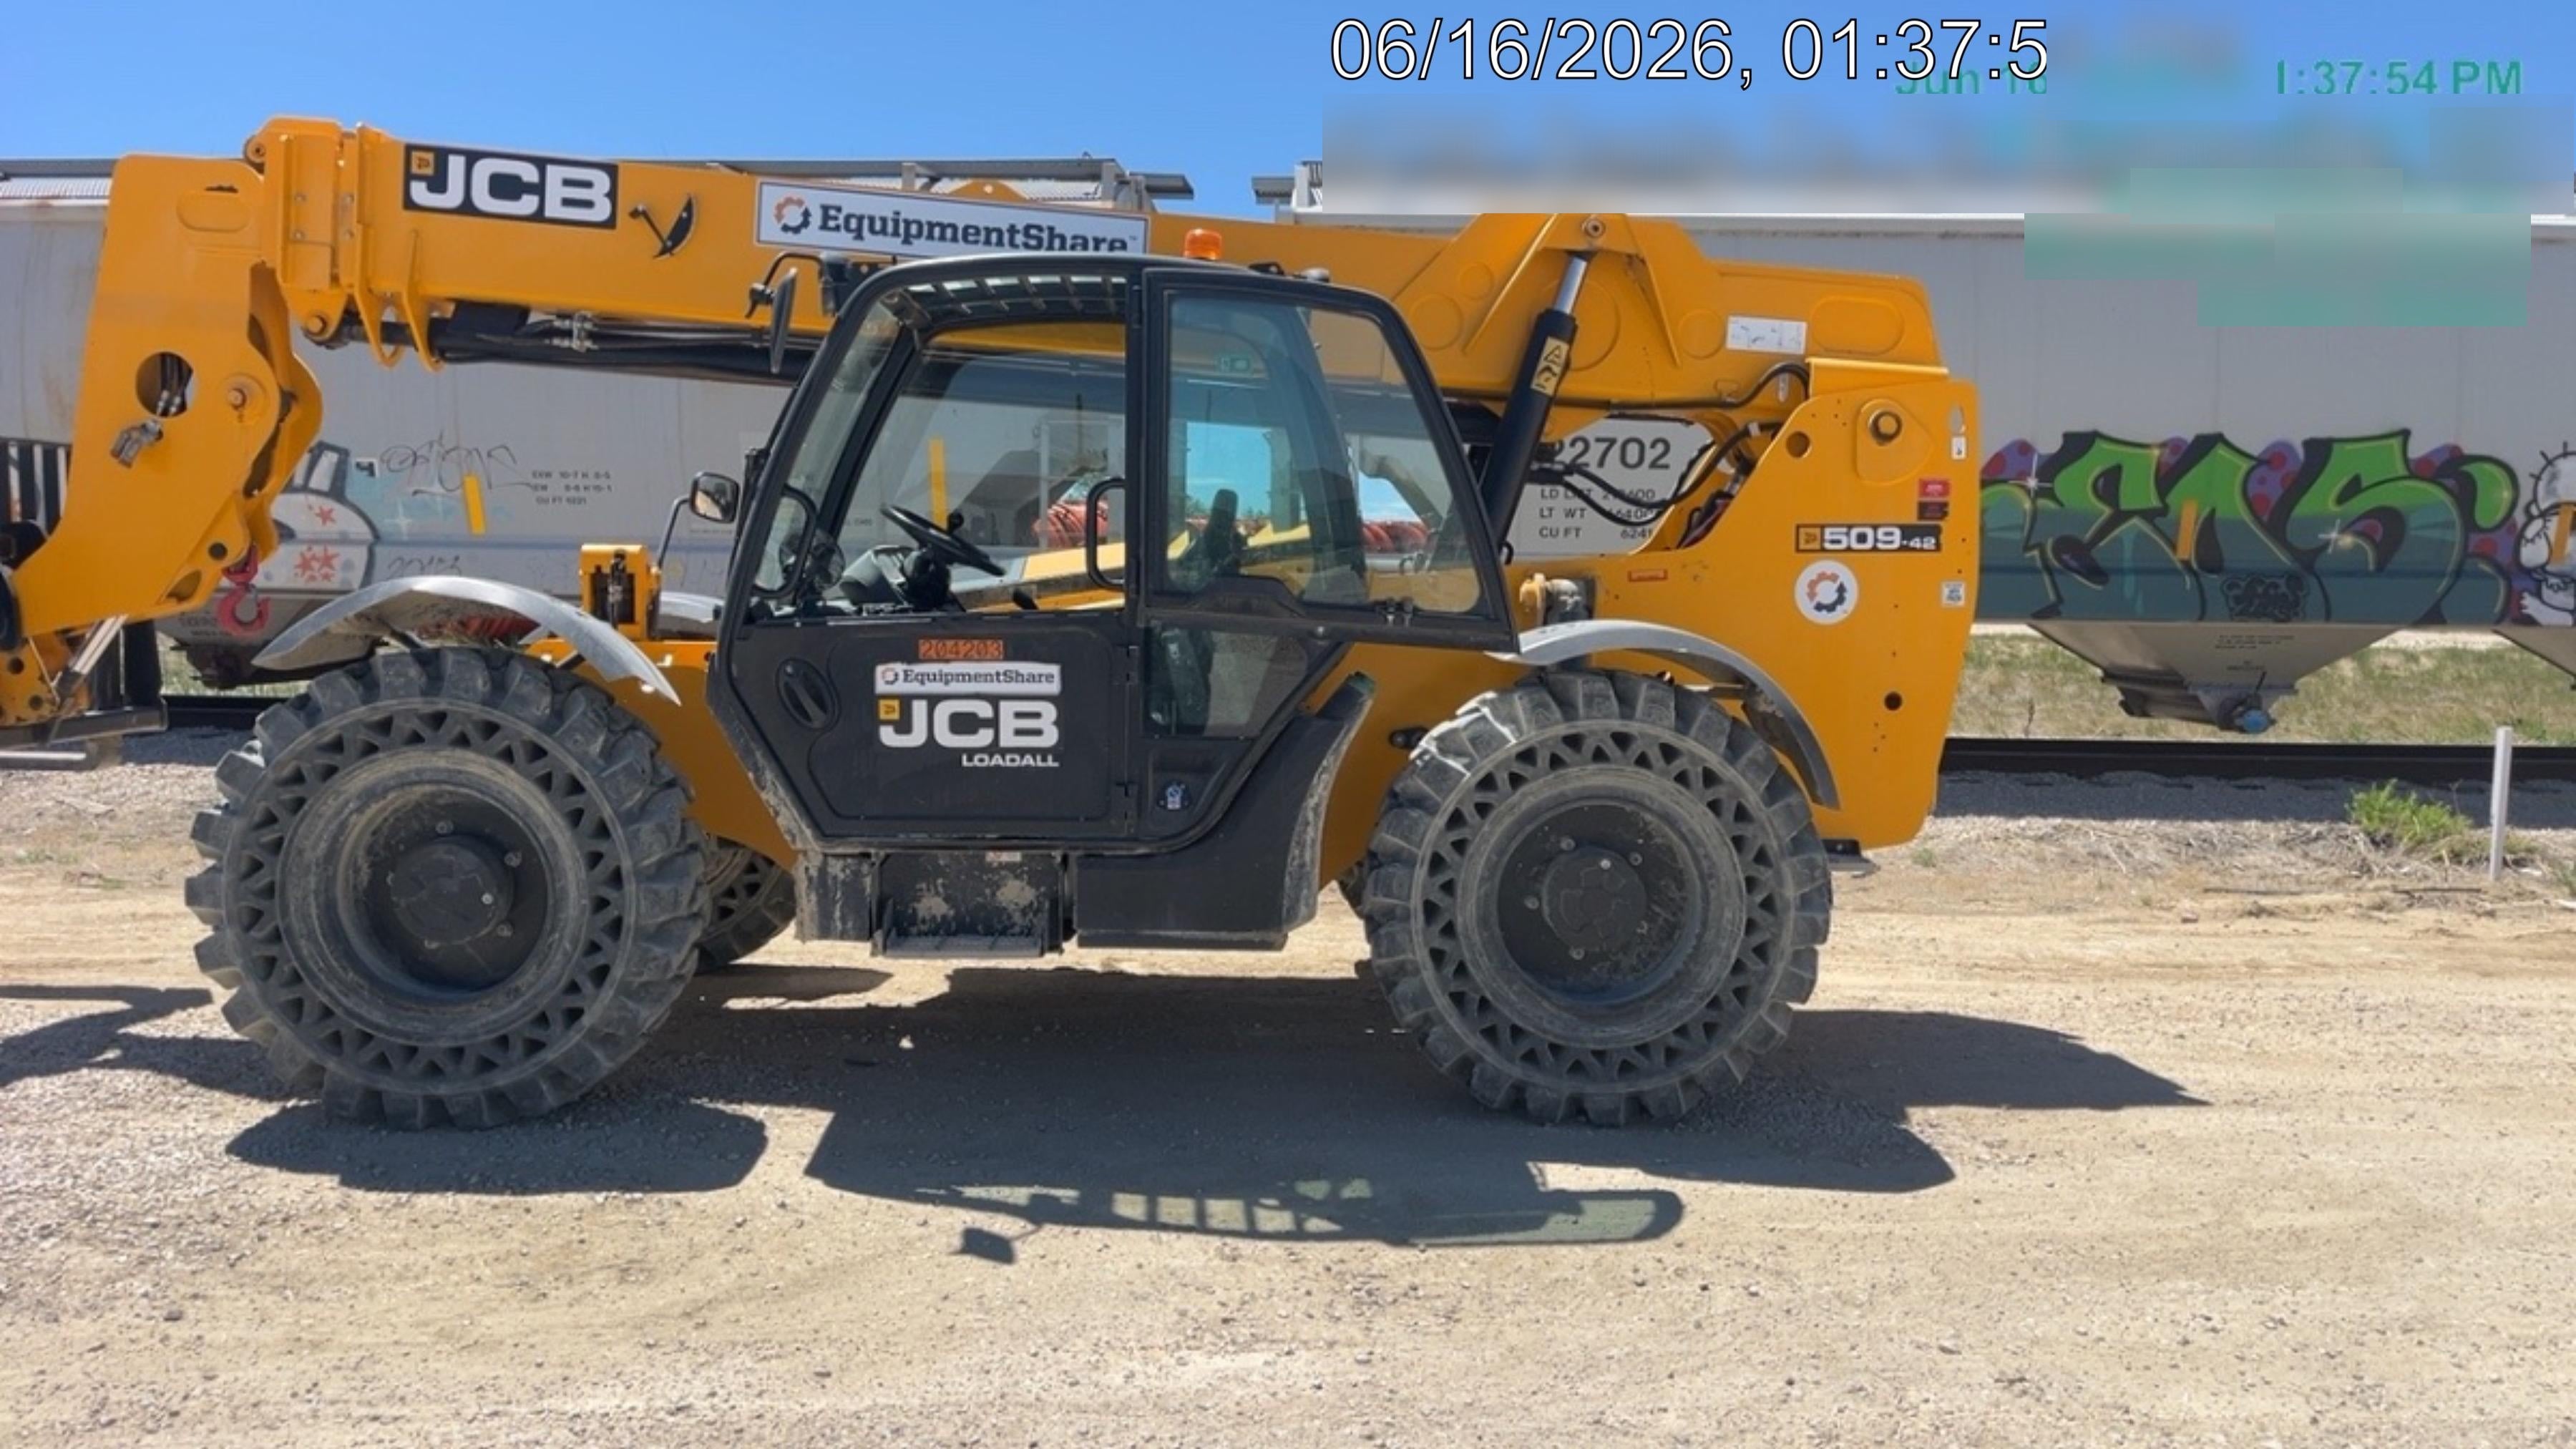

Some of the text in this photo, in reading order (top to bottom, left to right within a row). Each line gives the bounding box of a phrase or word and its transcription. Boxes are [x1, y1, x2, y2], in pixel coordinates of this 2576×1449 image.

[409, 153, 613, 223] JCB
[818, 203, 1128, 253] EquipmentShare
[1556, 436, 1672, 469] 2702
[1563, 507, 1587, 519] WT
[1539, 527, 1559, 538] CU
[1563, 527, 1582, 537] FT
[921, 640, 1002, 658] 204203
[902, 669, 1055, 686] EquipmentShare
[879, 698, 1060, 748] JCB
[962, 753, 1060, 768] LOADALL
